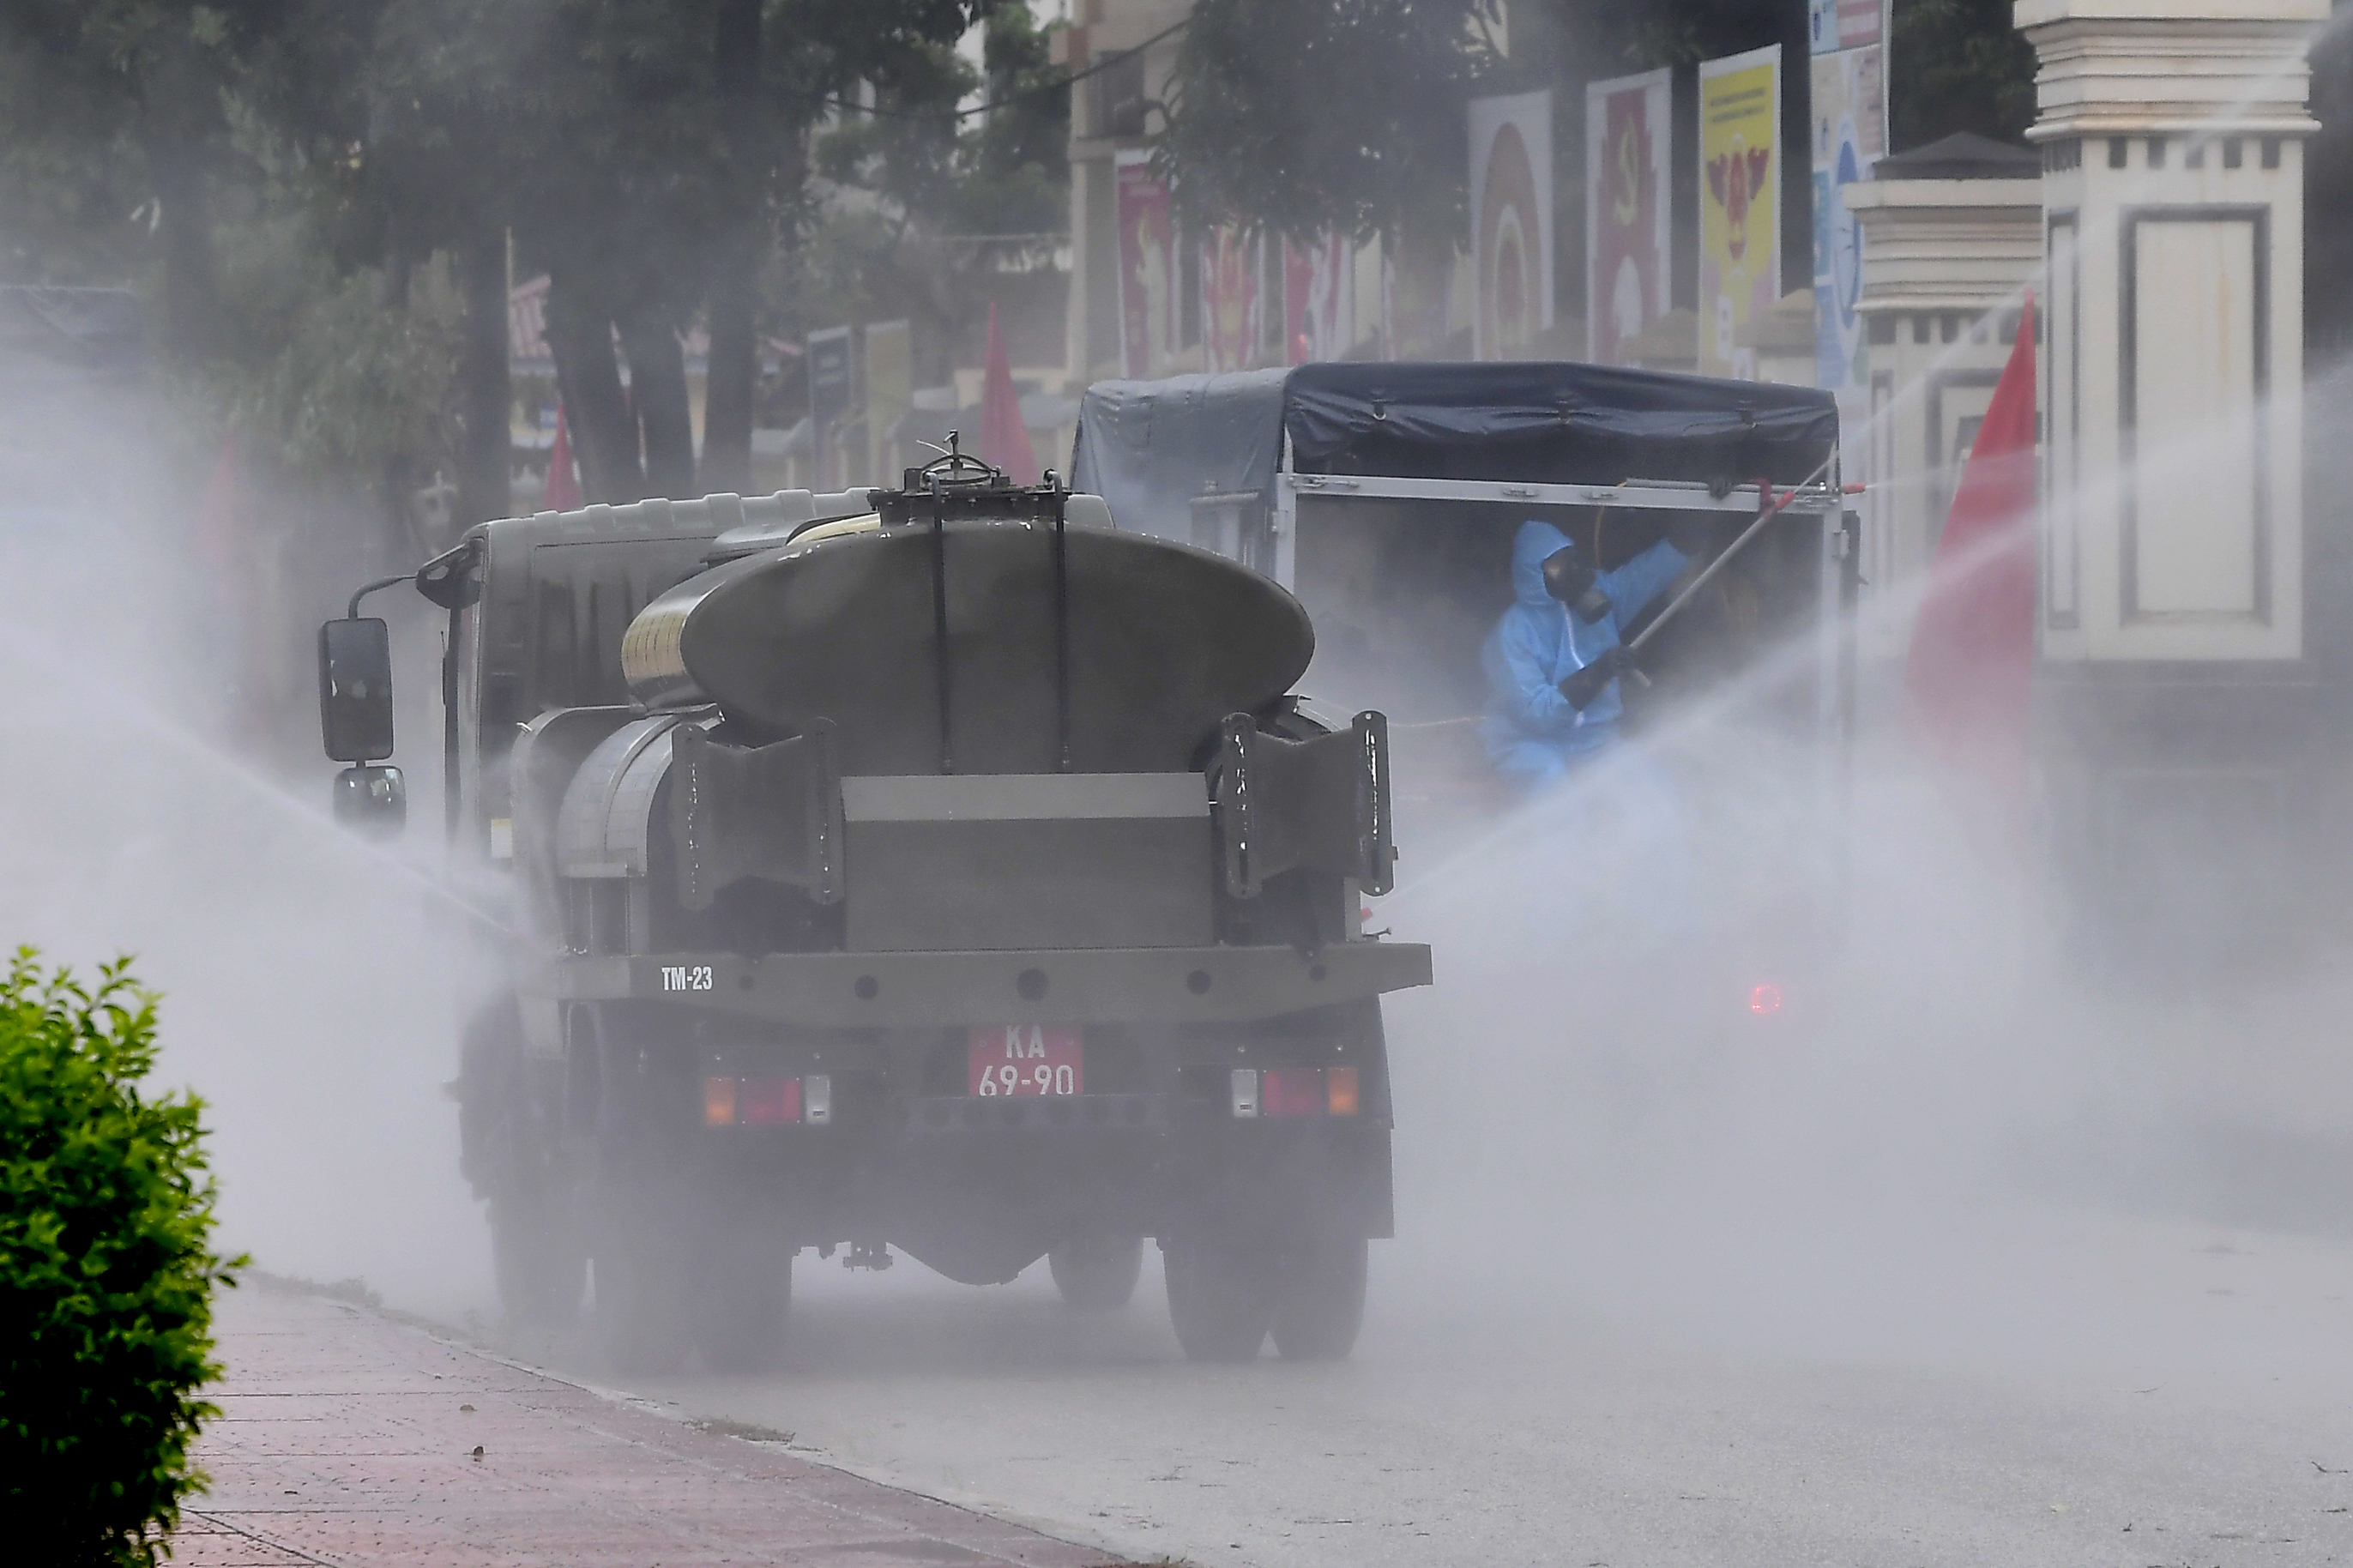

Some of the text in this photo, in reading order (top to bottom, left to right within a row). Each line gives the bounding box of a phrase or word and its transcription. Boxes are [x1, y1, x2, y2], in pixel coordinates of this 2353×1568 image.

[661, 966, 713, 991] TM-23
[1005, 1024, 1046, 1058] KA
[979, 1064, 1074, 1096] 69-90
